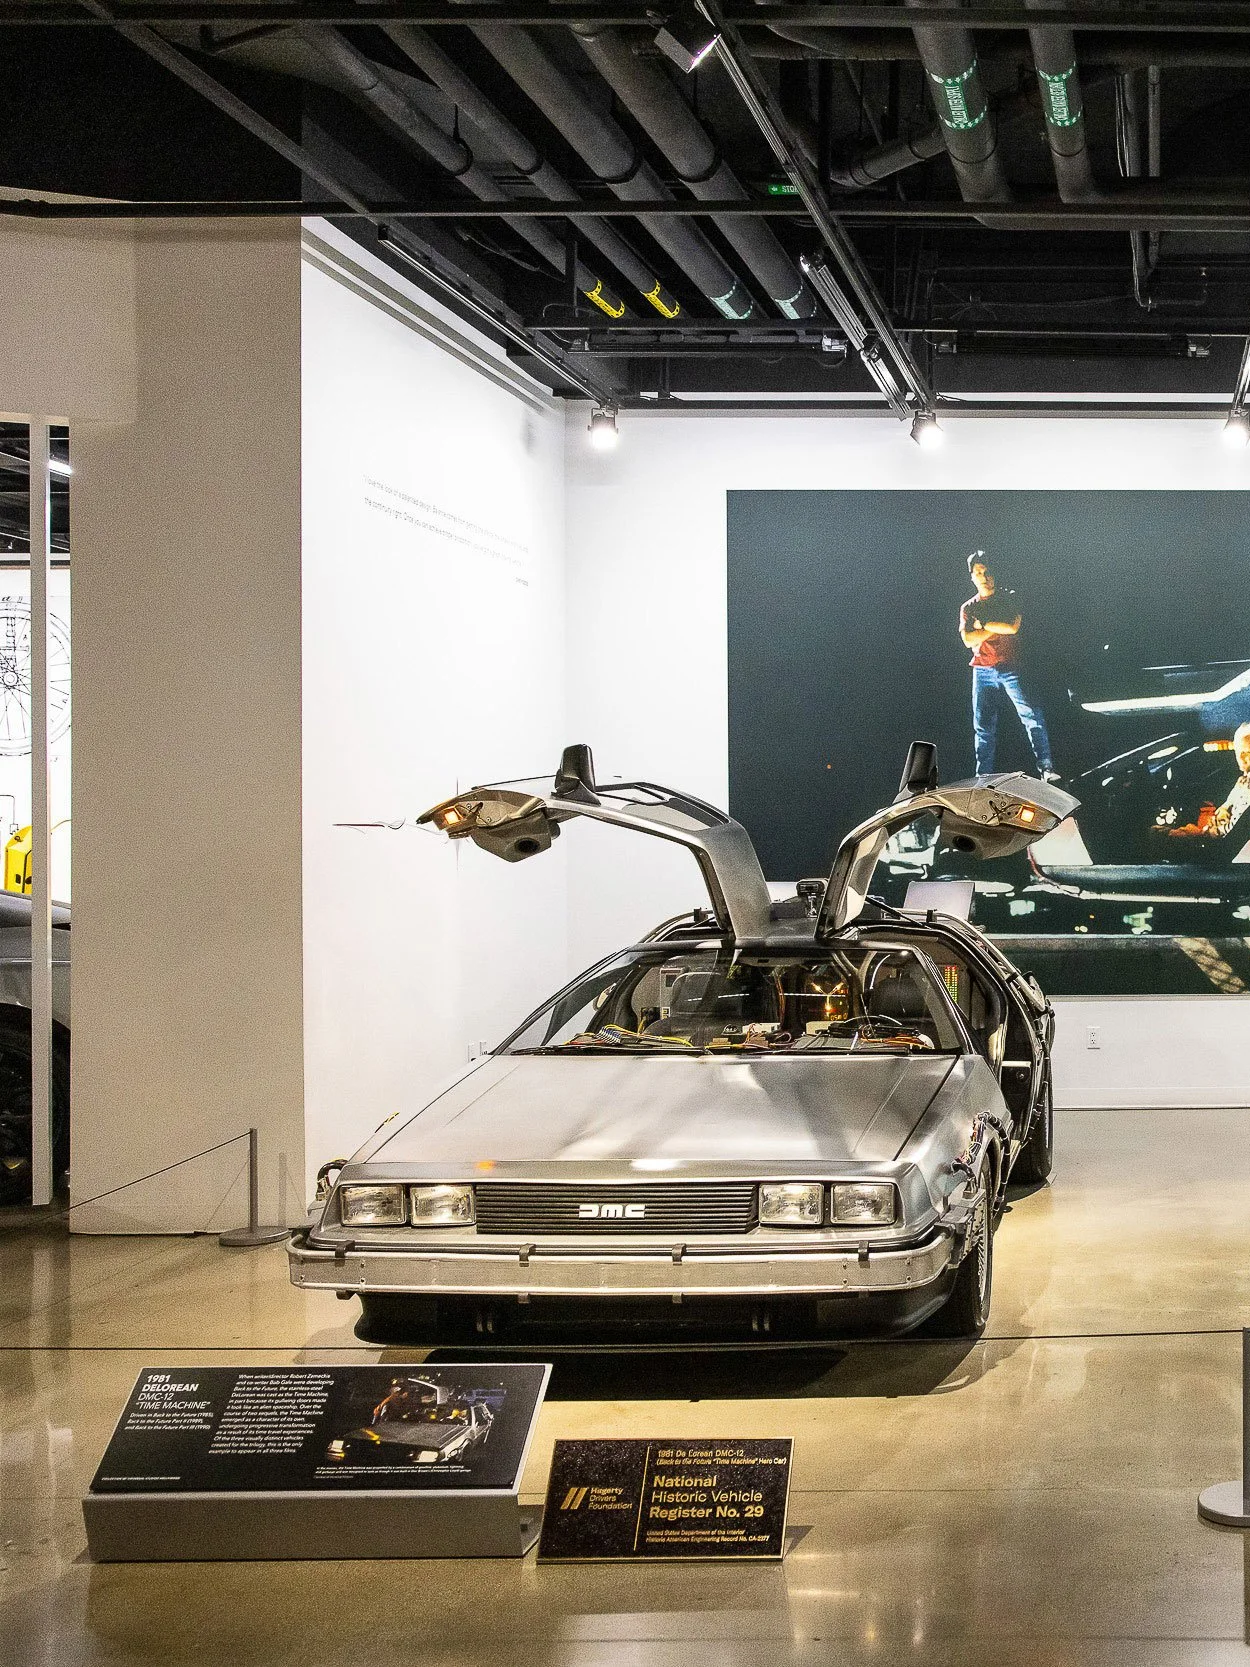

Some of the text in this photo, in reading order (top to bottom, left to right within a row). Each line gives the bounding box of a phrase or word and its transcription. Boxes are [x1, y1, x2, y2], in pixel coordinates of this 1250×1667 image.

[654, 1475, 716, 1487] National
[652, 1490, 762, 1502] Historic Vehicle
[649, 1506, 764, 1520] Register No. 29
